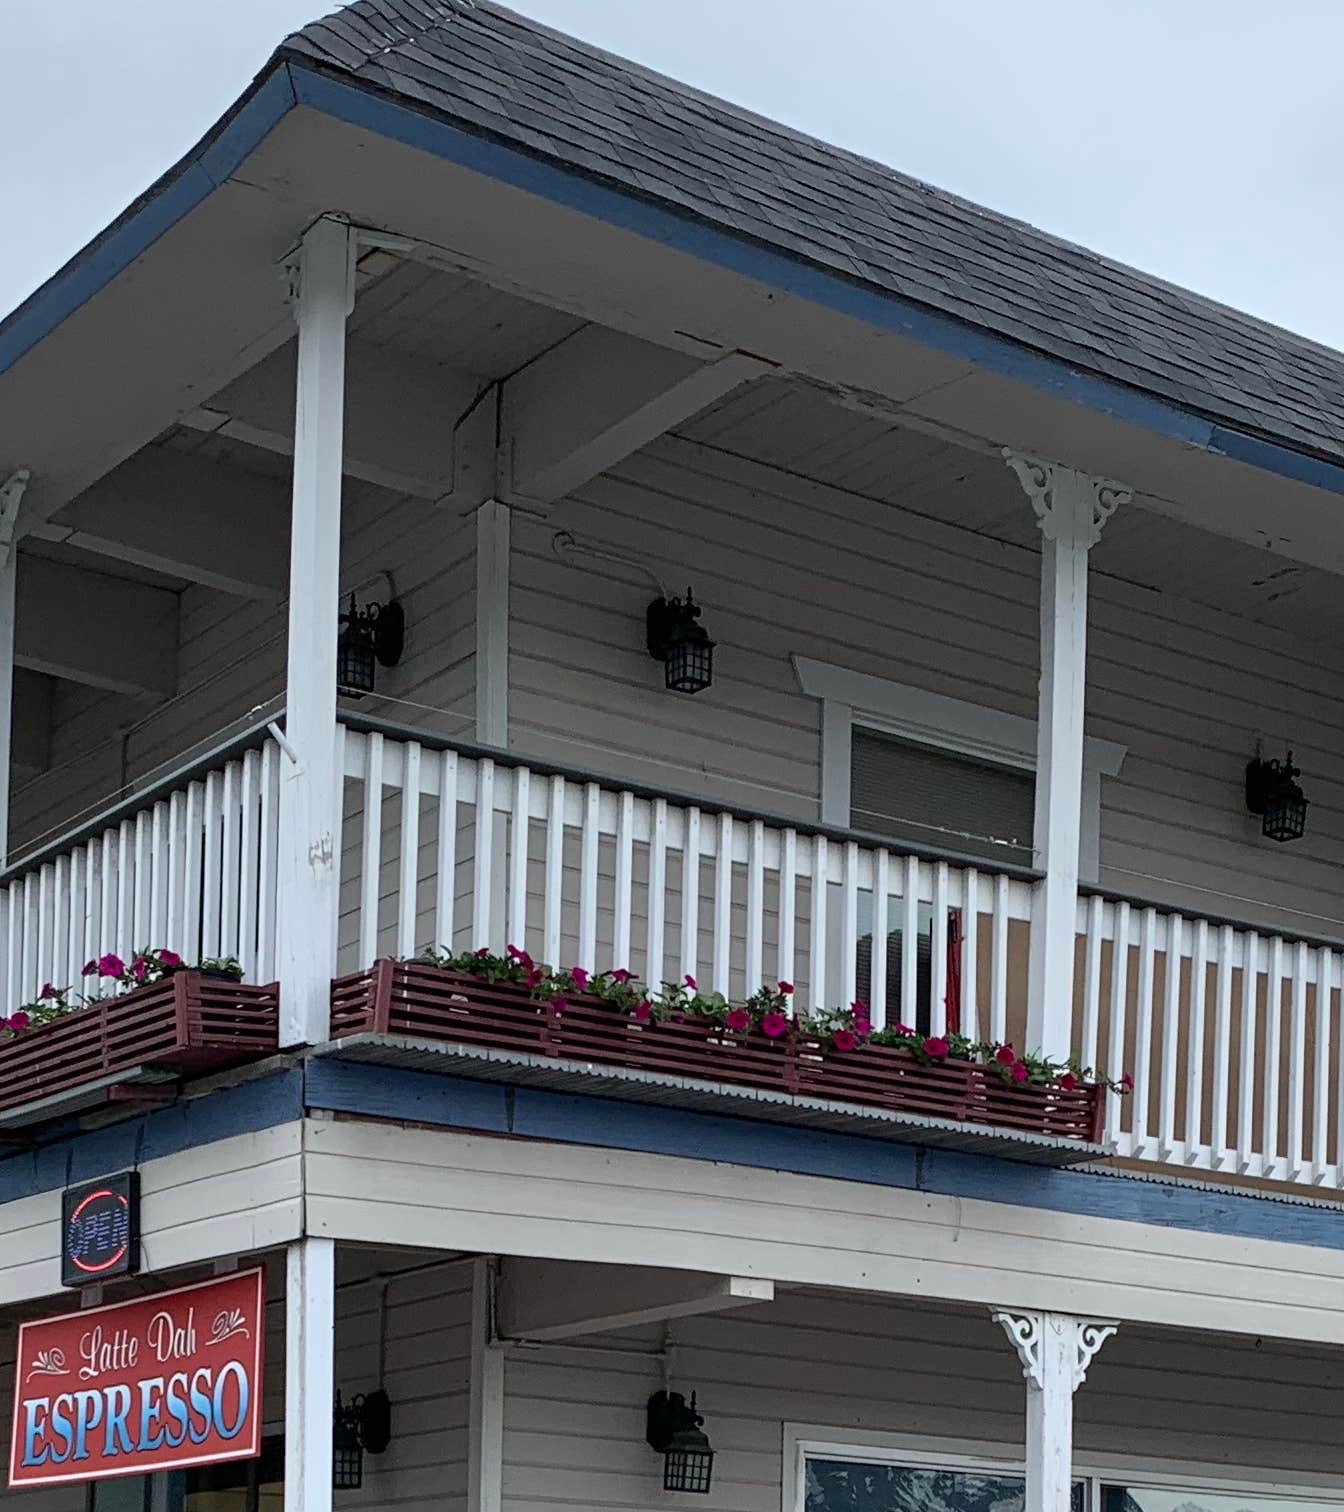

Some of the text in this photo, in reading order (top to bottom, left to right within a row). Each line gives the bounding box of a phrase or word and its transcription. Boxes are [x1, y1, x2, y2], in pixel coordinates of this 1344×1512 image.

[67, 1208, 128, 1260] OPEN
[78, 1306, 197, 1381] Latte Dah
[21, 1360, 250, 1468] ESPRESSO
